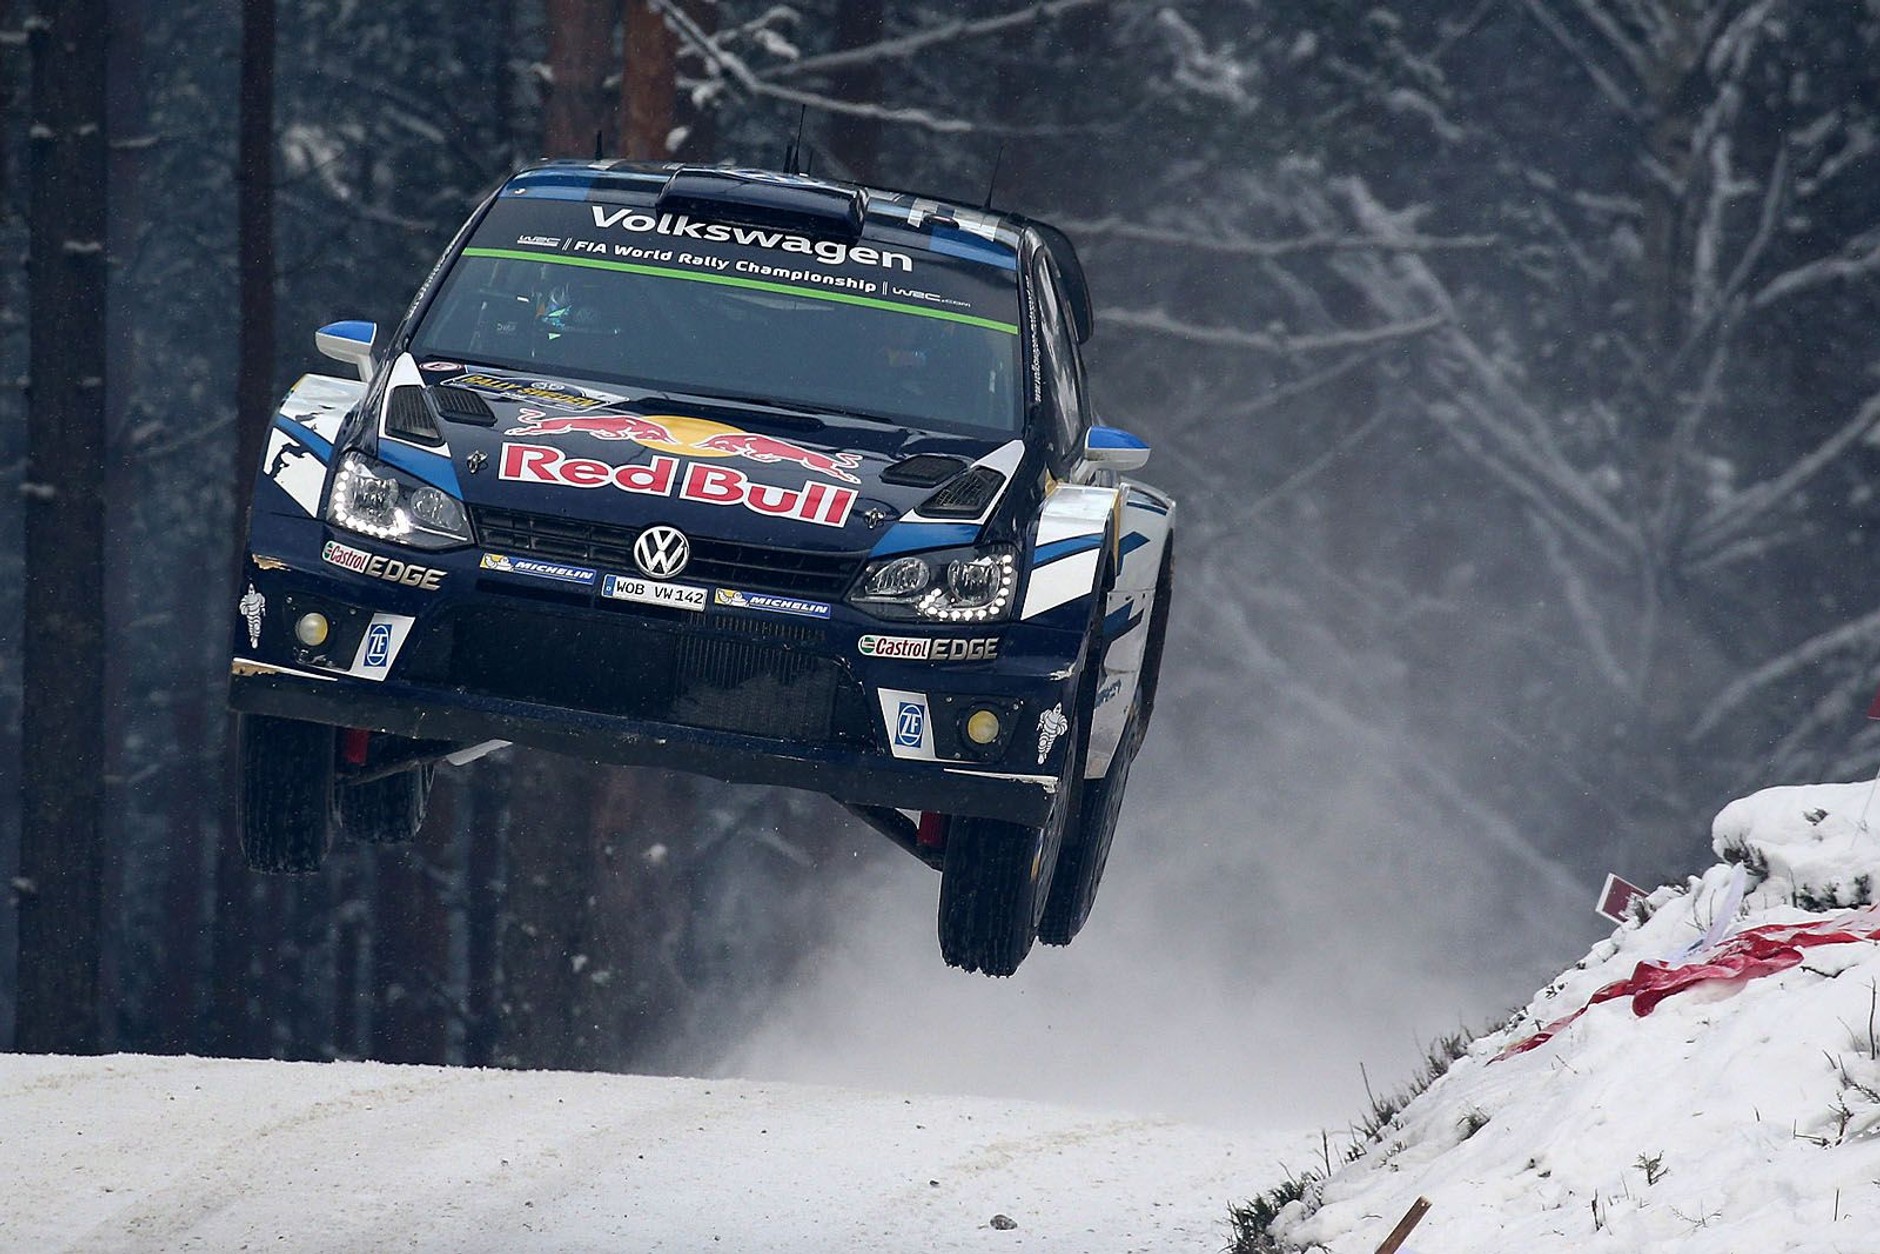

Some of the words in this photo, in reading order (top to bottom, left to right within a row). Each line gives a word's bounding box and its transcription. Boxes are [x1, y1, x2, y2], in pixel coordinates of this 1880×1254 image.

[591, 205, 913, 273] Volkswagen
[574, 240, 607, 254] FIA
[614, 244, 672, 261] World
[678, 252, 730, 271] Rally
[735, 260, 877, 293] Championship
[461, 375, 522, 391] RALLY
[518, 387, 601, 408] SWEDEN
[501, 443, 678, 496] Red
[682, 463, 857, 526] Bull
[329, 544, 368, 573] Castrol
[365, 555, 448, 591] EDGE
[514, 560, 595, 581] MICHELIN
[616, 583, 645, 596] WOB
[654, 586, 673, 600] VW
[674, 589, 704, 605] 142
[748, 595, 829, 615] MICHELIN
[366, 633, 386, 657] ZF
[875, 637, 928, 658] Castrol
[929, 637, 999, 661] EDGE
[900, 712, 919, 736] ZF
